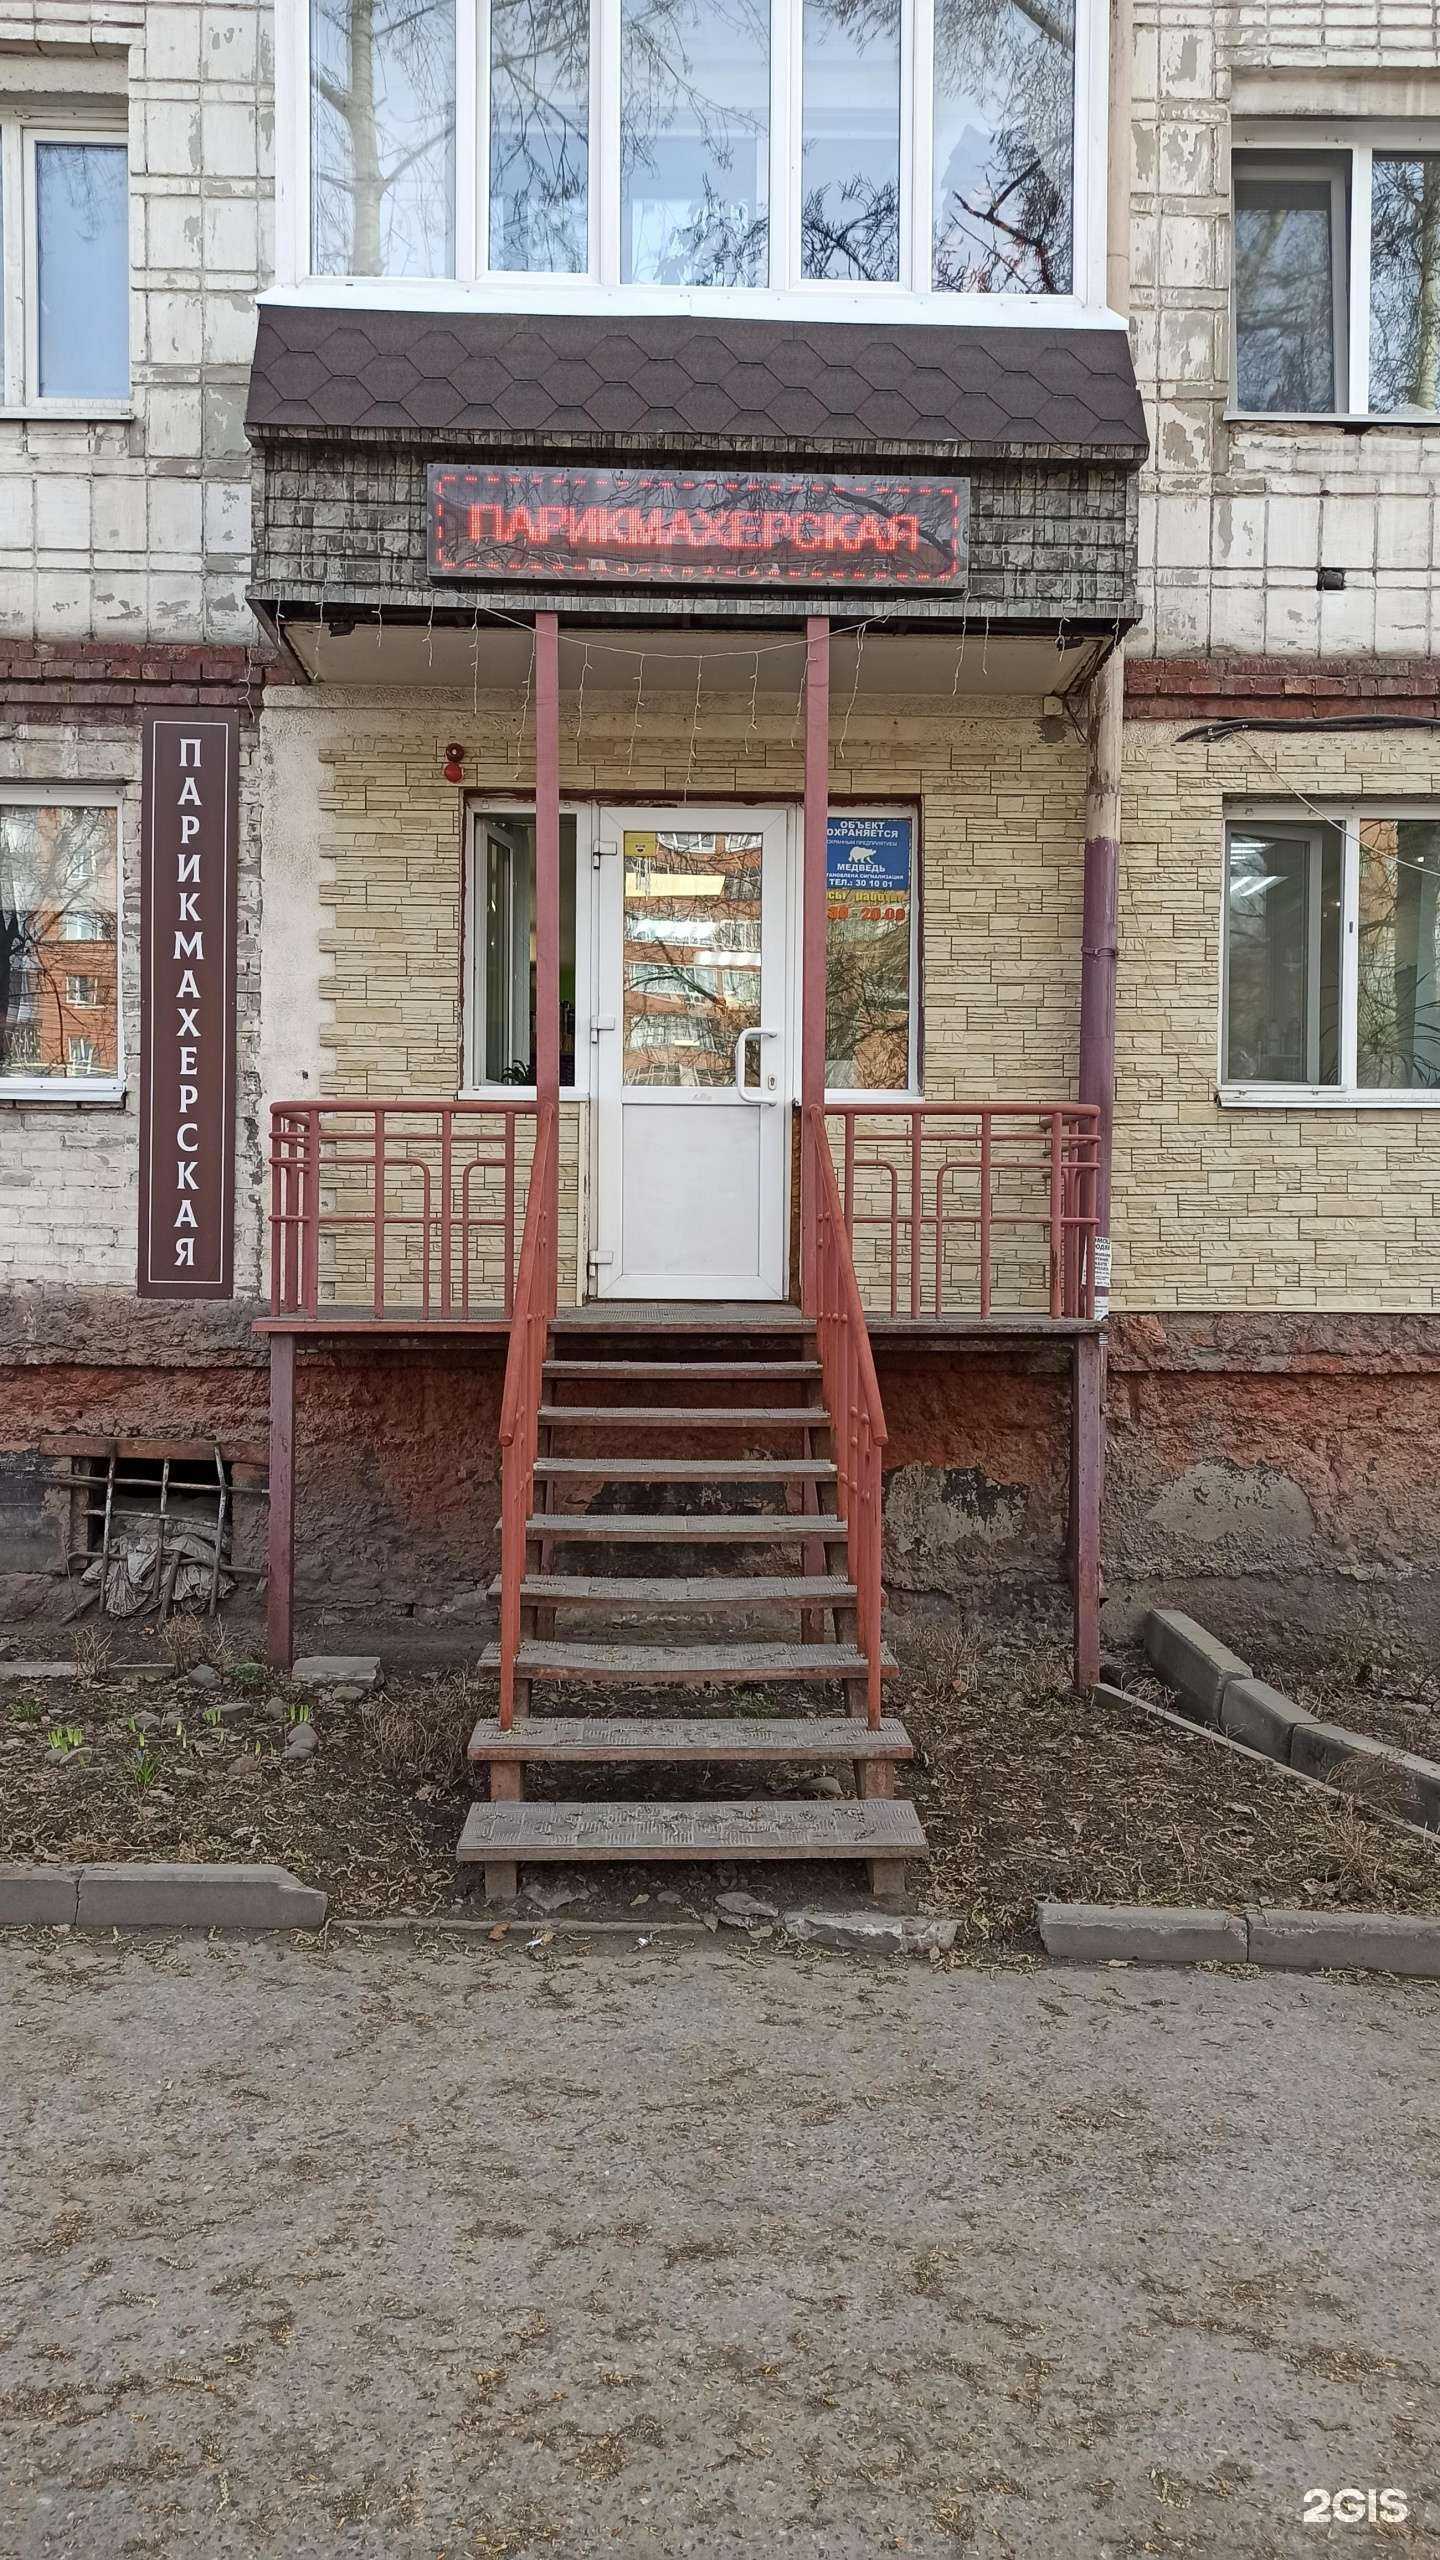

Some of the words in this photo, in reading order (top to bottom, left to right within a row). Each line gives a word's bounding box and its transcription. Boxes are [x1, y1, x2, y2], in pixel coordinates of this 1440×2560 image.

[467, 502, 919, 551] ПАРИКМАХЕРСКАЯ
[840, 820, 885, 830] ОБЪЕКТ
[826, 828, 899, 838] ОХРАНЯЕТСЯ
[836, 863, 886, 873] МЕДВЕДЬ
[173, 738, 205, 1267] ПАРИКМАХЕРСКАЯ
